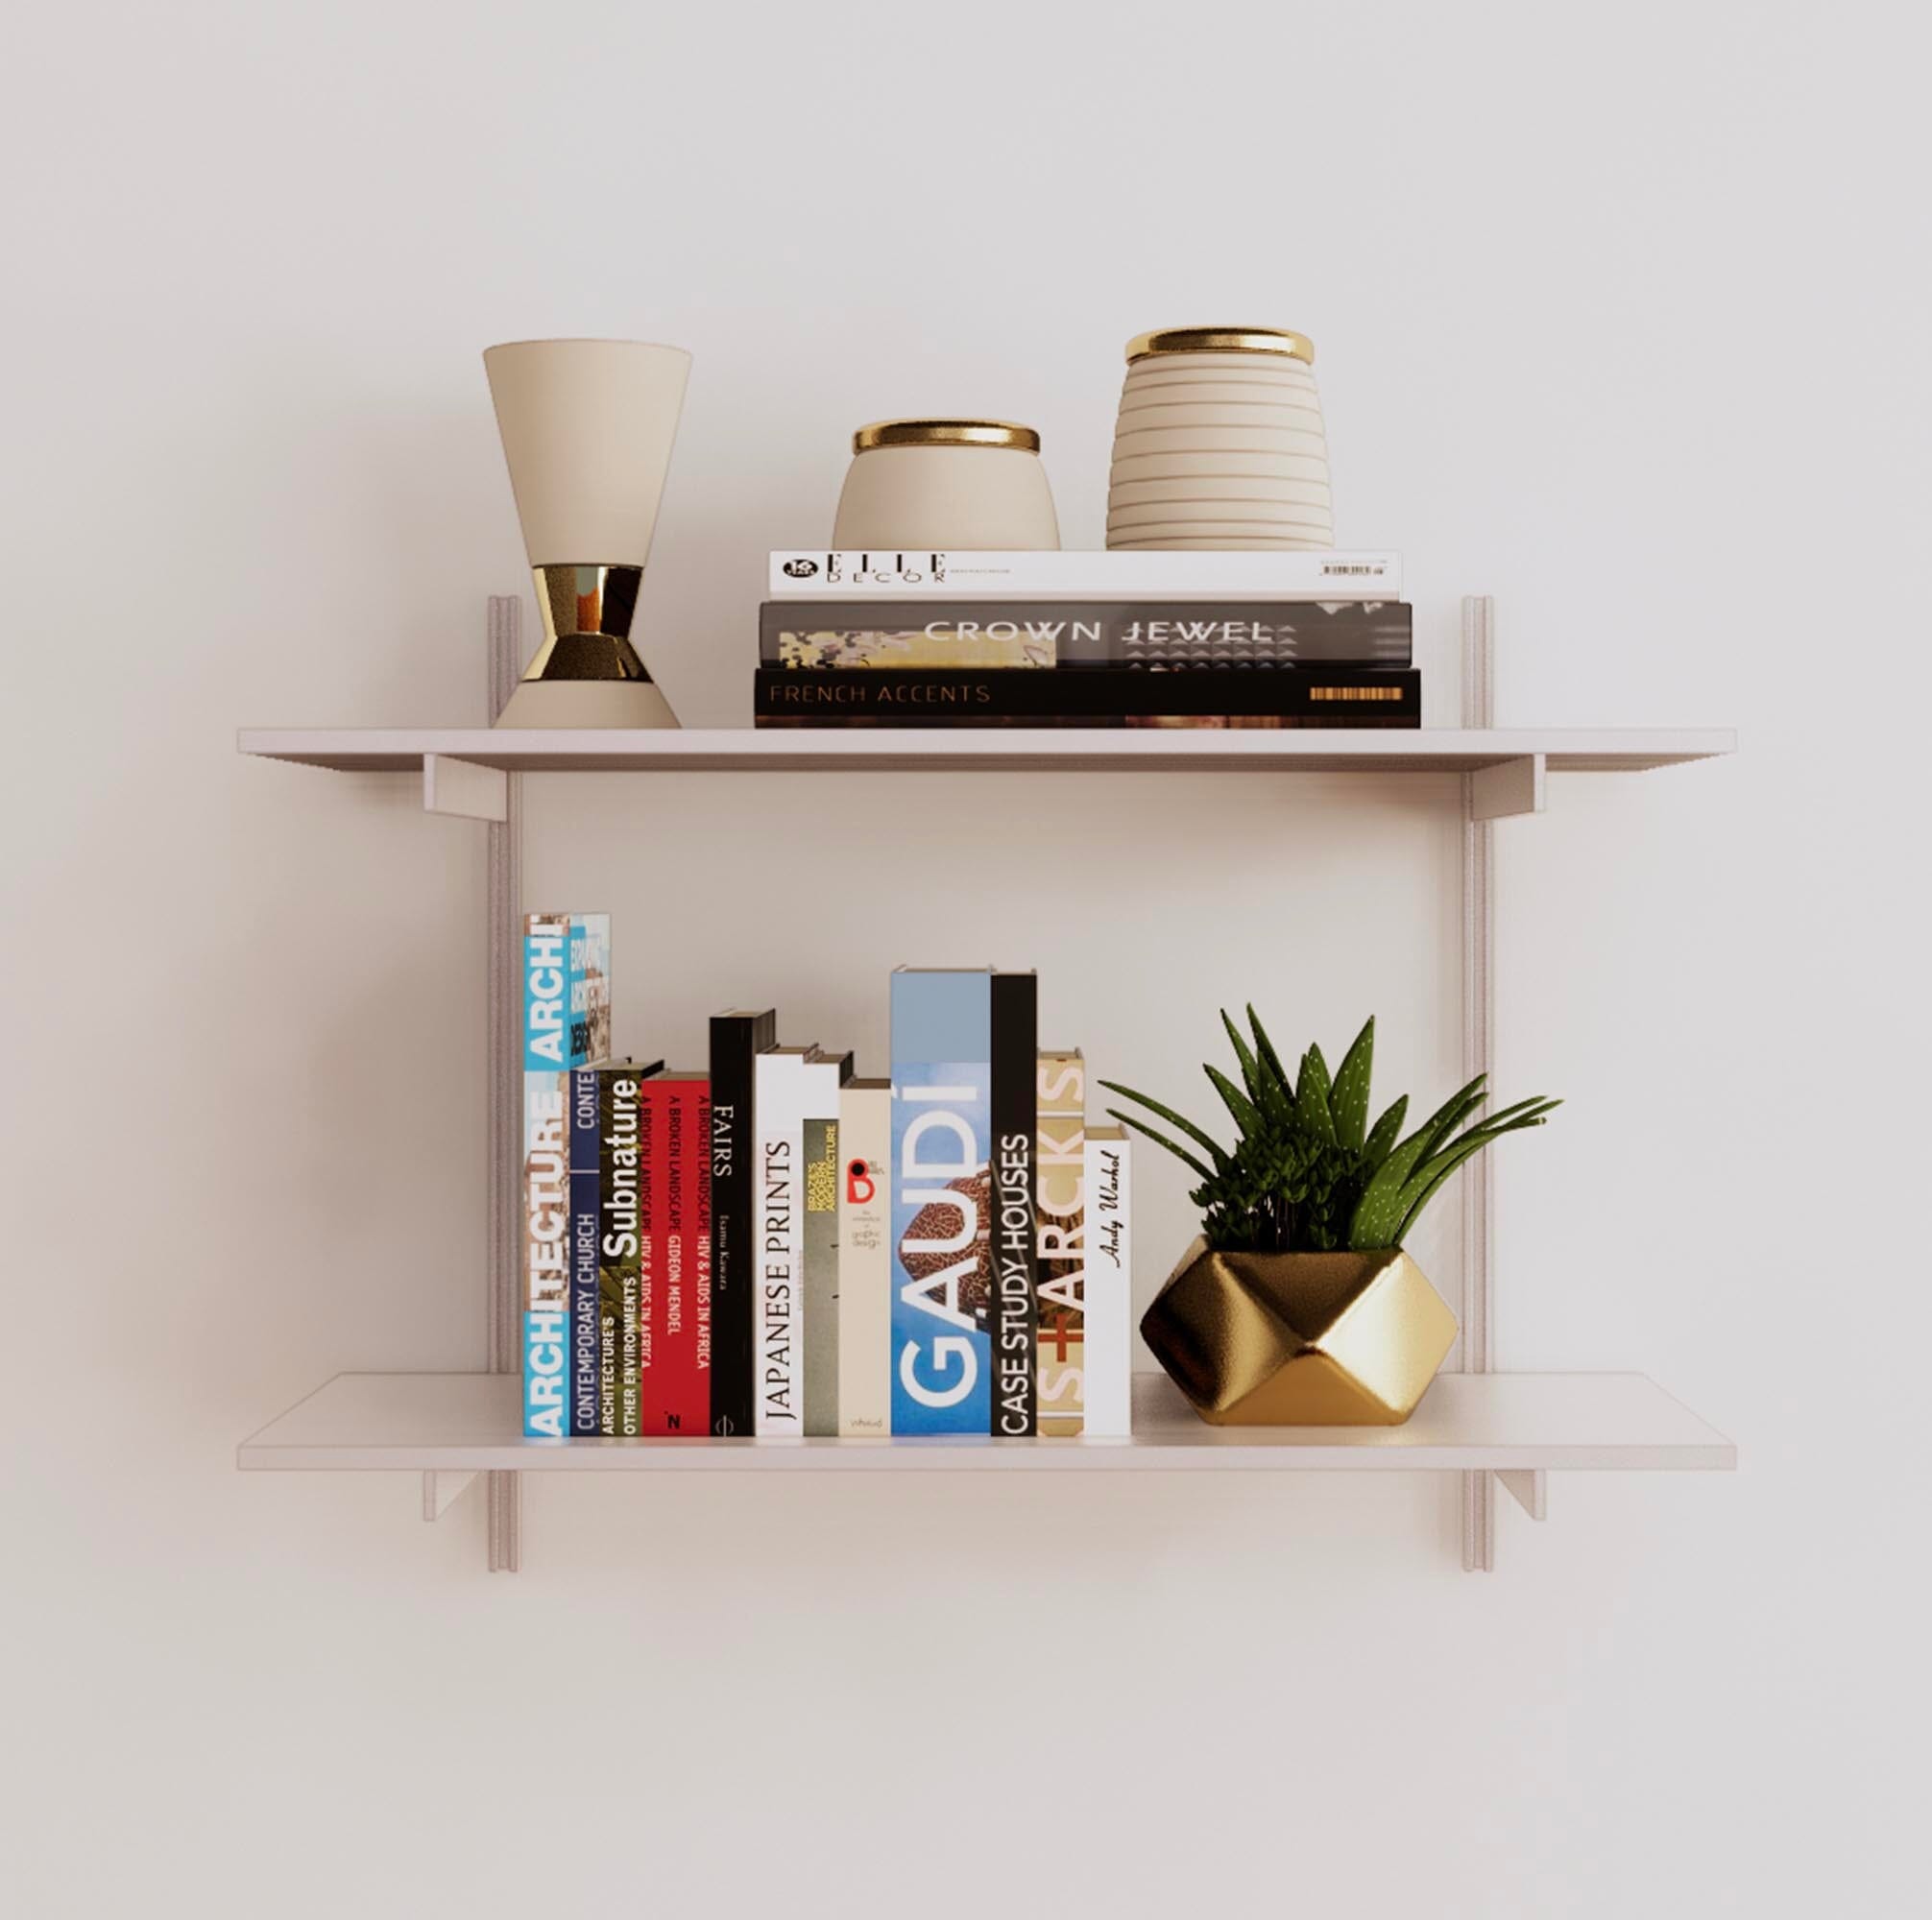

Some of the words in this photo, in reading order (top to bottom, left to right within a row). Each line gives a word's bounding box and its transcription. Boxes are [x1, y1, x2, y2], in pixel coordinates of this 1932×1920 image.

[827, 554, 946, 573] ELLE
[827, 573, 946, 584] DECOR
[925, 620, 1101, 642] CROWN
[1121, 620, 1274, 642] JEWEL
[770, 684, 866, 704] FRENCH
[878, 684, 991, 704] ACCENTS
[667, 1096, 681, 1105] A
[698, 1096, 711, 1105] A
[667, 1109, 681, 1158] BROKEN
[698, 1109, 711, 1158] BROKEN
[712, 1105, 734, 1177] FAIRS
[604, 1079, 639, 1258] Subnature
[825, 1125, 836, 1212] ARCHITECTURE
[1002, 1133, 1028, 1249] HOUSES
[1099, 1150, 1120, 1212] Warhol
[667, 1161, 681, 1232] LANDSCAPE
[698, 1161, 711, 1232] LANDSCAPE
[765, 1140, 791, 1254] PRINTS
[529, 1092, 564, 1436] ARCHITECTURE
[577, 1213, 595, 1283] CHURCH
[667, 1236, 681, 1283] GIDEON
[698, 1236, 711, 1258] HIV
[698, 1260, 711, 1271] &
[1099, 1219, 1123, 1269] Andy
[667, 1286, 681, 1335] MENDEL
[698, 1274, 711, 1304] AIDS
[698, 1307, 711, 1321] IN
[1002, 1257, 1028, 1352] STUDY
[624, 1277, 637, 1385] ENVIRONMENTS
[698, 1324, 711, 1369] AFRICA
[765, 1264, 796, 1421] JAPANESE
[577, 1287, 595, 1430] CONTEMPORARY
[602, 1316, 615, 1435] ARCHITECTURE'S
[623, 1388, 637, 1435] OTHER
[1002, 1358, 1028, 1436] CASE
